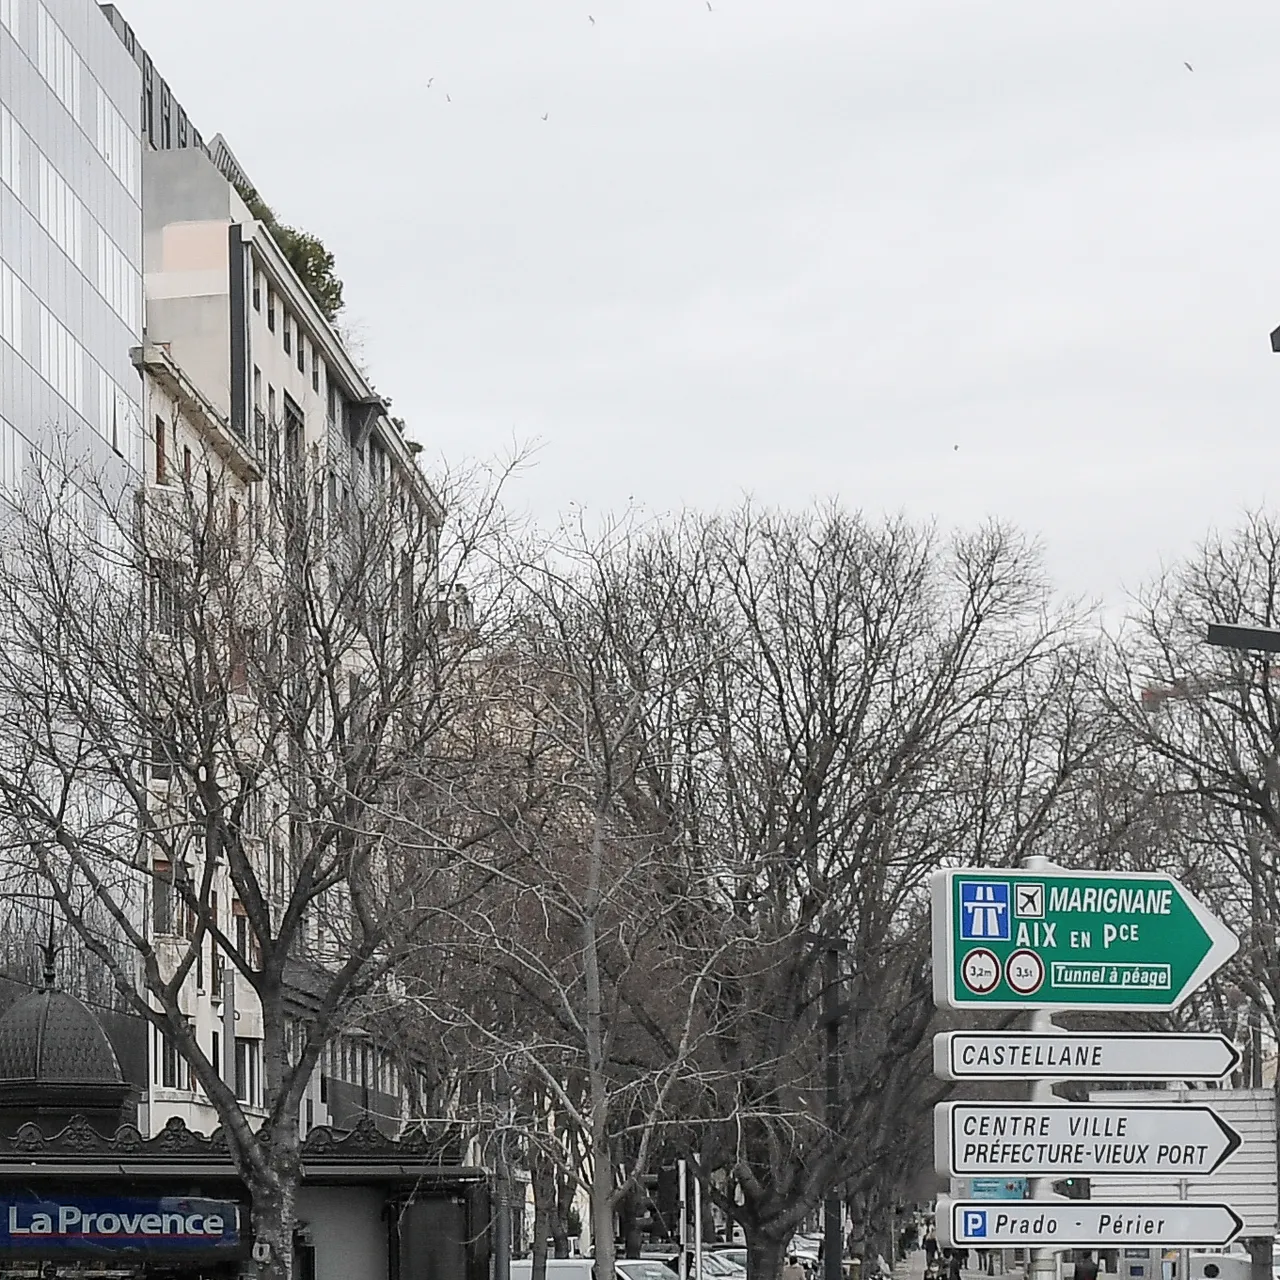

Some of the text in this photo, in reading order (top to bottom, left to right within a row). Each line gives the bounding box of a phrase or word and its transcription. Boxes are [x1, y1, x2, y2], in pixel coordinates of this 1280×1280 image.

[1049, 887, 1173, 915] MARIGNANE
[1015, 922, 1057, 948] AIX
[1070, 931, 1091, 948] EN
[970, 966, 992, 978] 3,2m
[1016, 966, 1033, 978] 3,5t
[1056, 965, 1168, 986] Tunnel à péage
[962, 1045, 1103, 1066] CASTELLANE
[963, 1116, 1128, 1137] CENTRE VILLE
[963, 1139, 1208, 1165] PRÉFECTURE-VIEUX PORT
[8, 1206, 224, 1235] La Provence
[966, 1213, 984, 1235] P
[995, 1214, 1058, 1235] Prado
[1099, 1214, 1165, 1235] Périer
